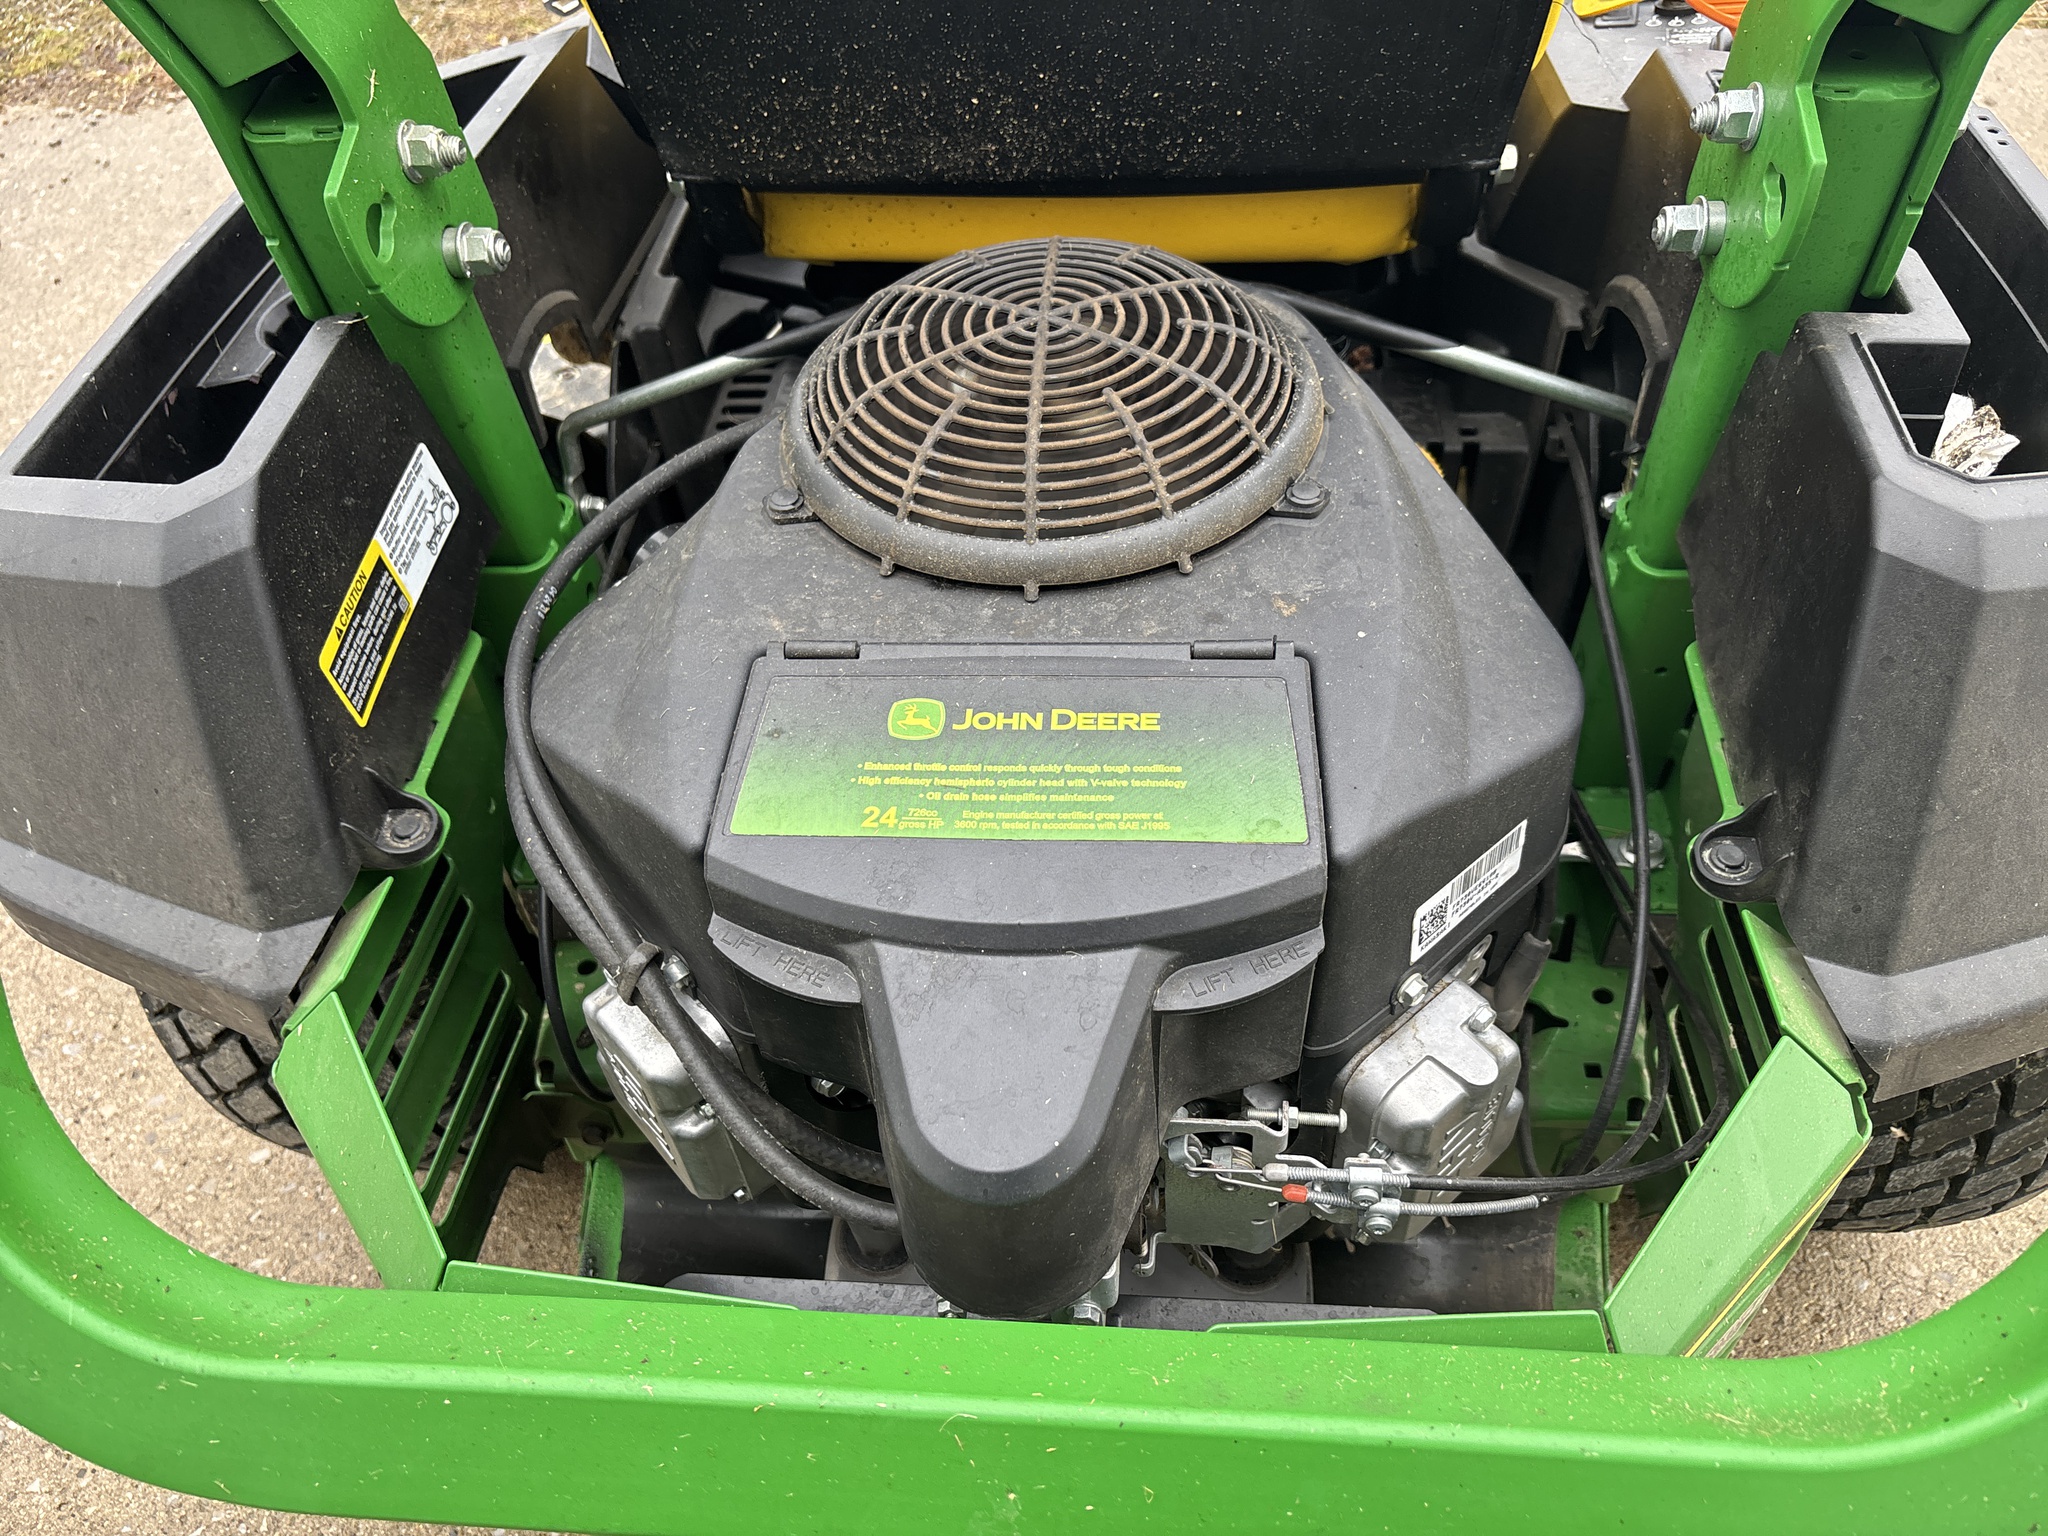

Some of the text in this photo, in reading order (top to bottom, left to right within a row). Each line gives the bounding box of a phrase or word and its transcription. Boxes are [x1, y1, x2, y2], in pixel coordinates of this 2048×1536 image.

[340, 571, 367, 627] CAUTION
[952, 708, 1161, 731] JOHN DEERE
[864, 762, 1183, 774] Enhanced throttle control responds quickly through tough conditions
[858, 776, 1188, 789] High efficiency hemispheric cylinder head with V-valve technology
[926, 792, 1115, 802] Oil drain hose simplifies maintenance
[861, 805, 898, 828] 24
[907, 807, 939, 817] 726cc
[962, 810, 1164, 821] Engine manufacturer certified gross power at
[898, 820, 944, 830] gross HP
[954, 820, 1171, 831] 3600 rpm, tested in accordance with SAE J1995
[720, 930, 831, 989] LIFT HERE
[1188, 941, 1311, 998] LIFT HERE
